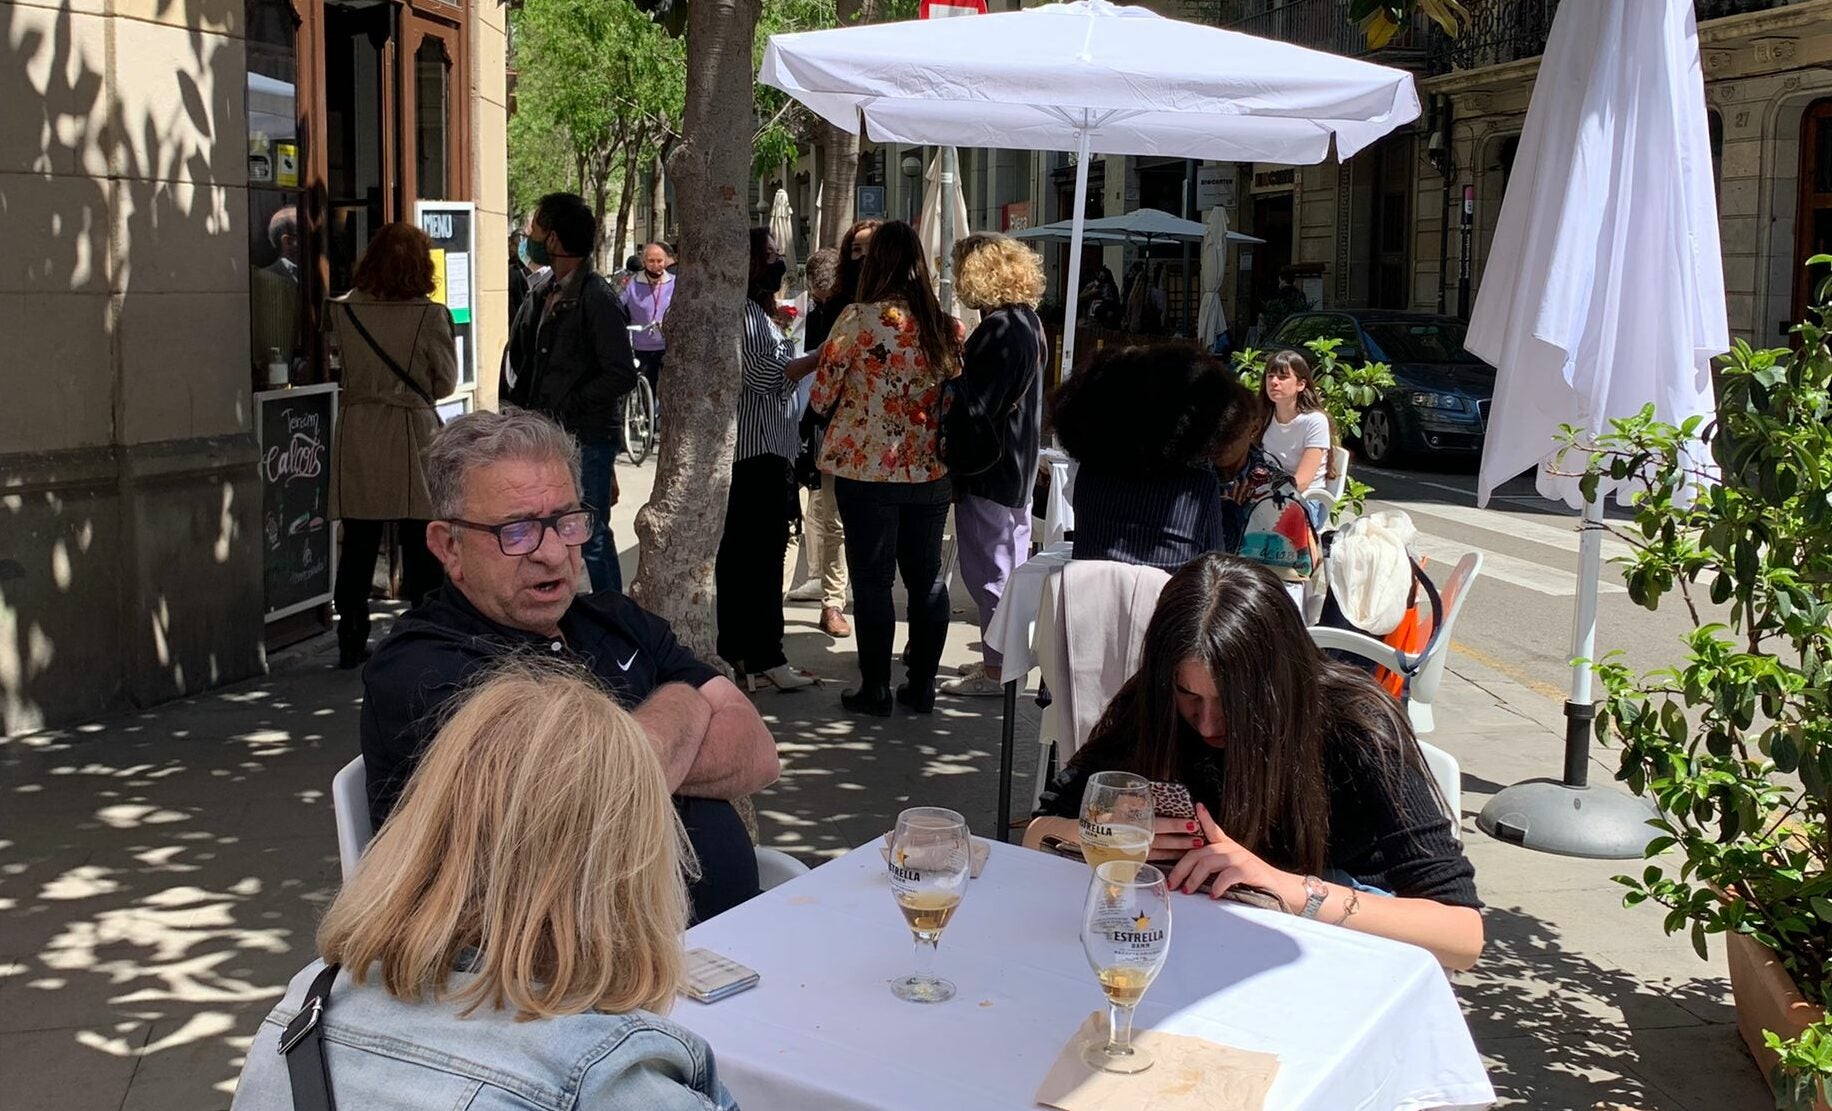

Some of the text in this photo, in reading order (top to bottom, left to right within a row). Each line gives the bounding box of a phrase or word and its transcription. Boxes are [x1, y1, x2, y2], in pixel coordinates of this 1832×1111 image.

[1735, 111, 1750, 128] 27
[423, 213, 453, 239] MENU
[888, 862, 921, 882] STRELLA
[1114, 929, 1164, 943] ESTRELLA
